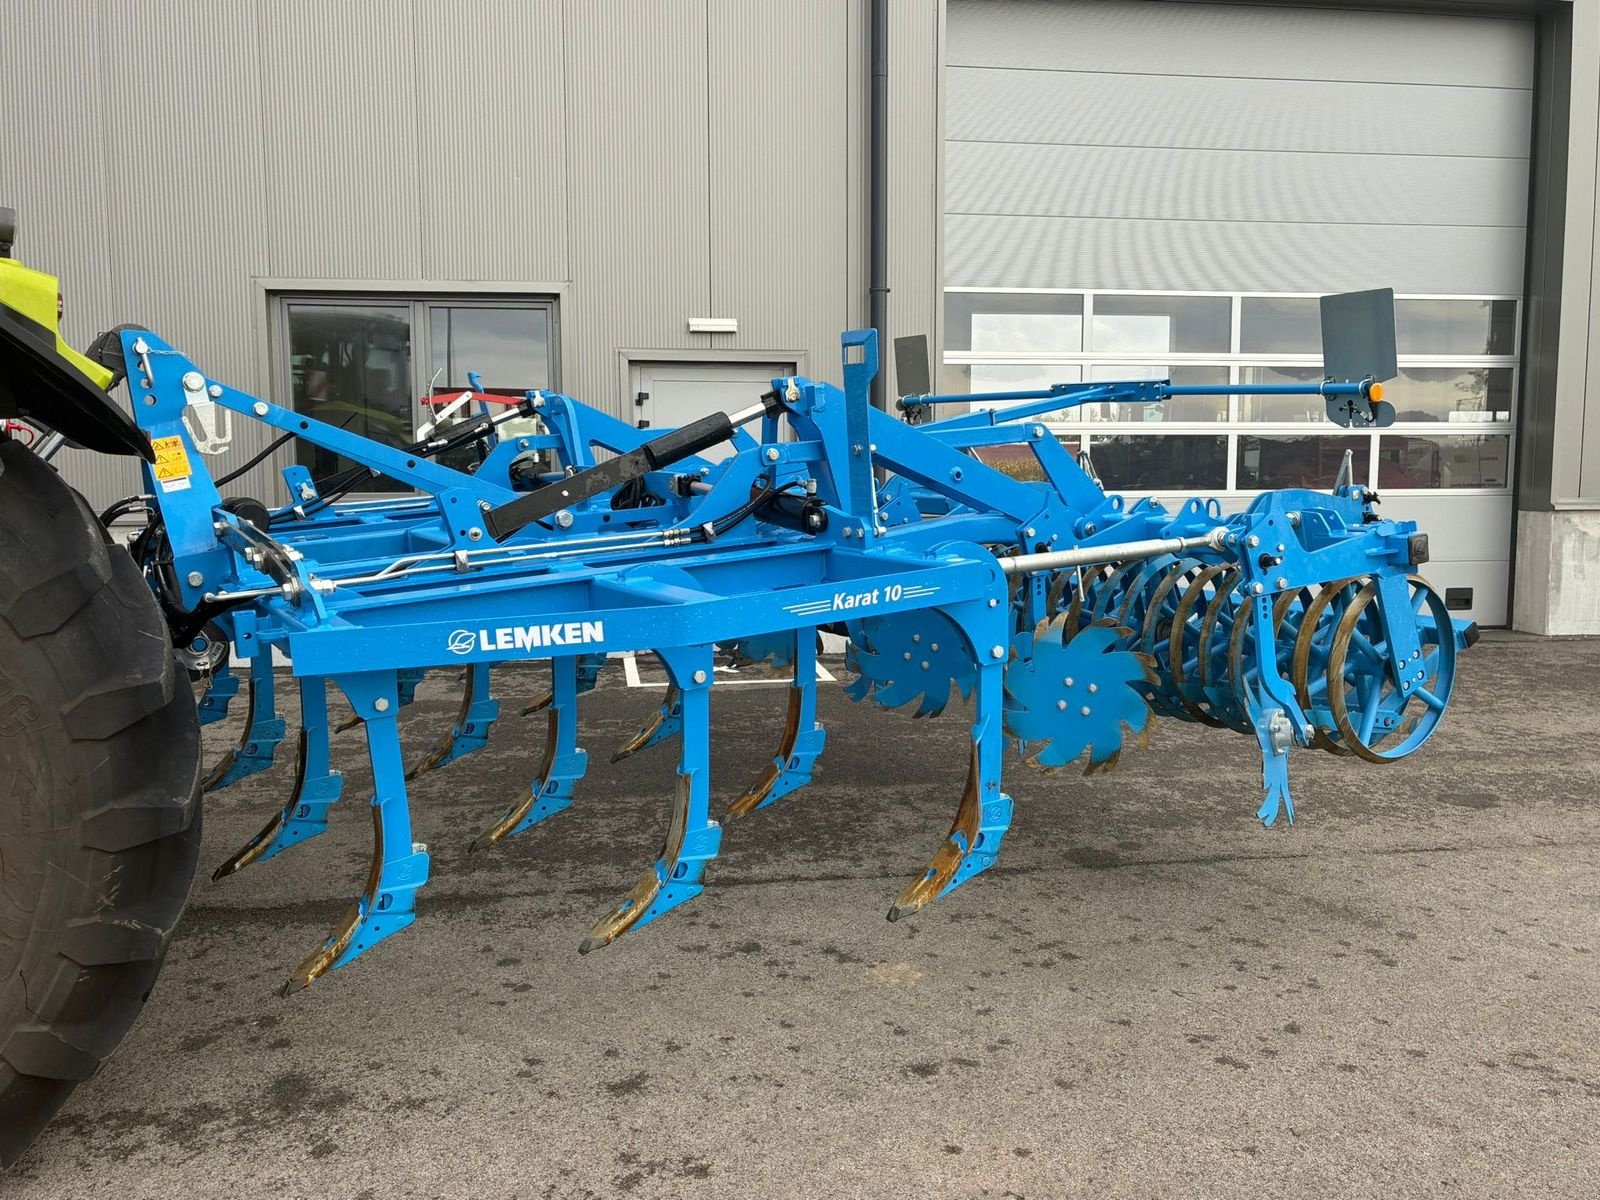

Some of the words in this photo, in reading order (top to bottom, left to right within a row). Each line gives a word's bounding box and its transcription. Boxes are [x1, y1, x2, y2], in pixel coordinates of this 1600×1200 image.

[832, 588, 880, 611] Karat
[883, 584, 902, 602] 10
[479, 621, 604, 653] LEMKEN
